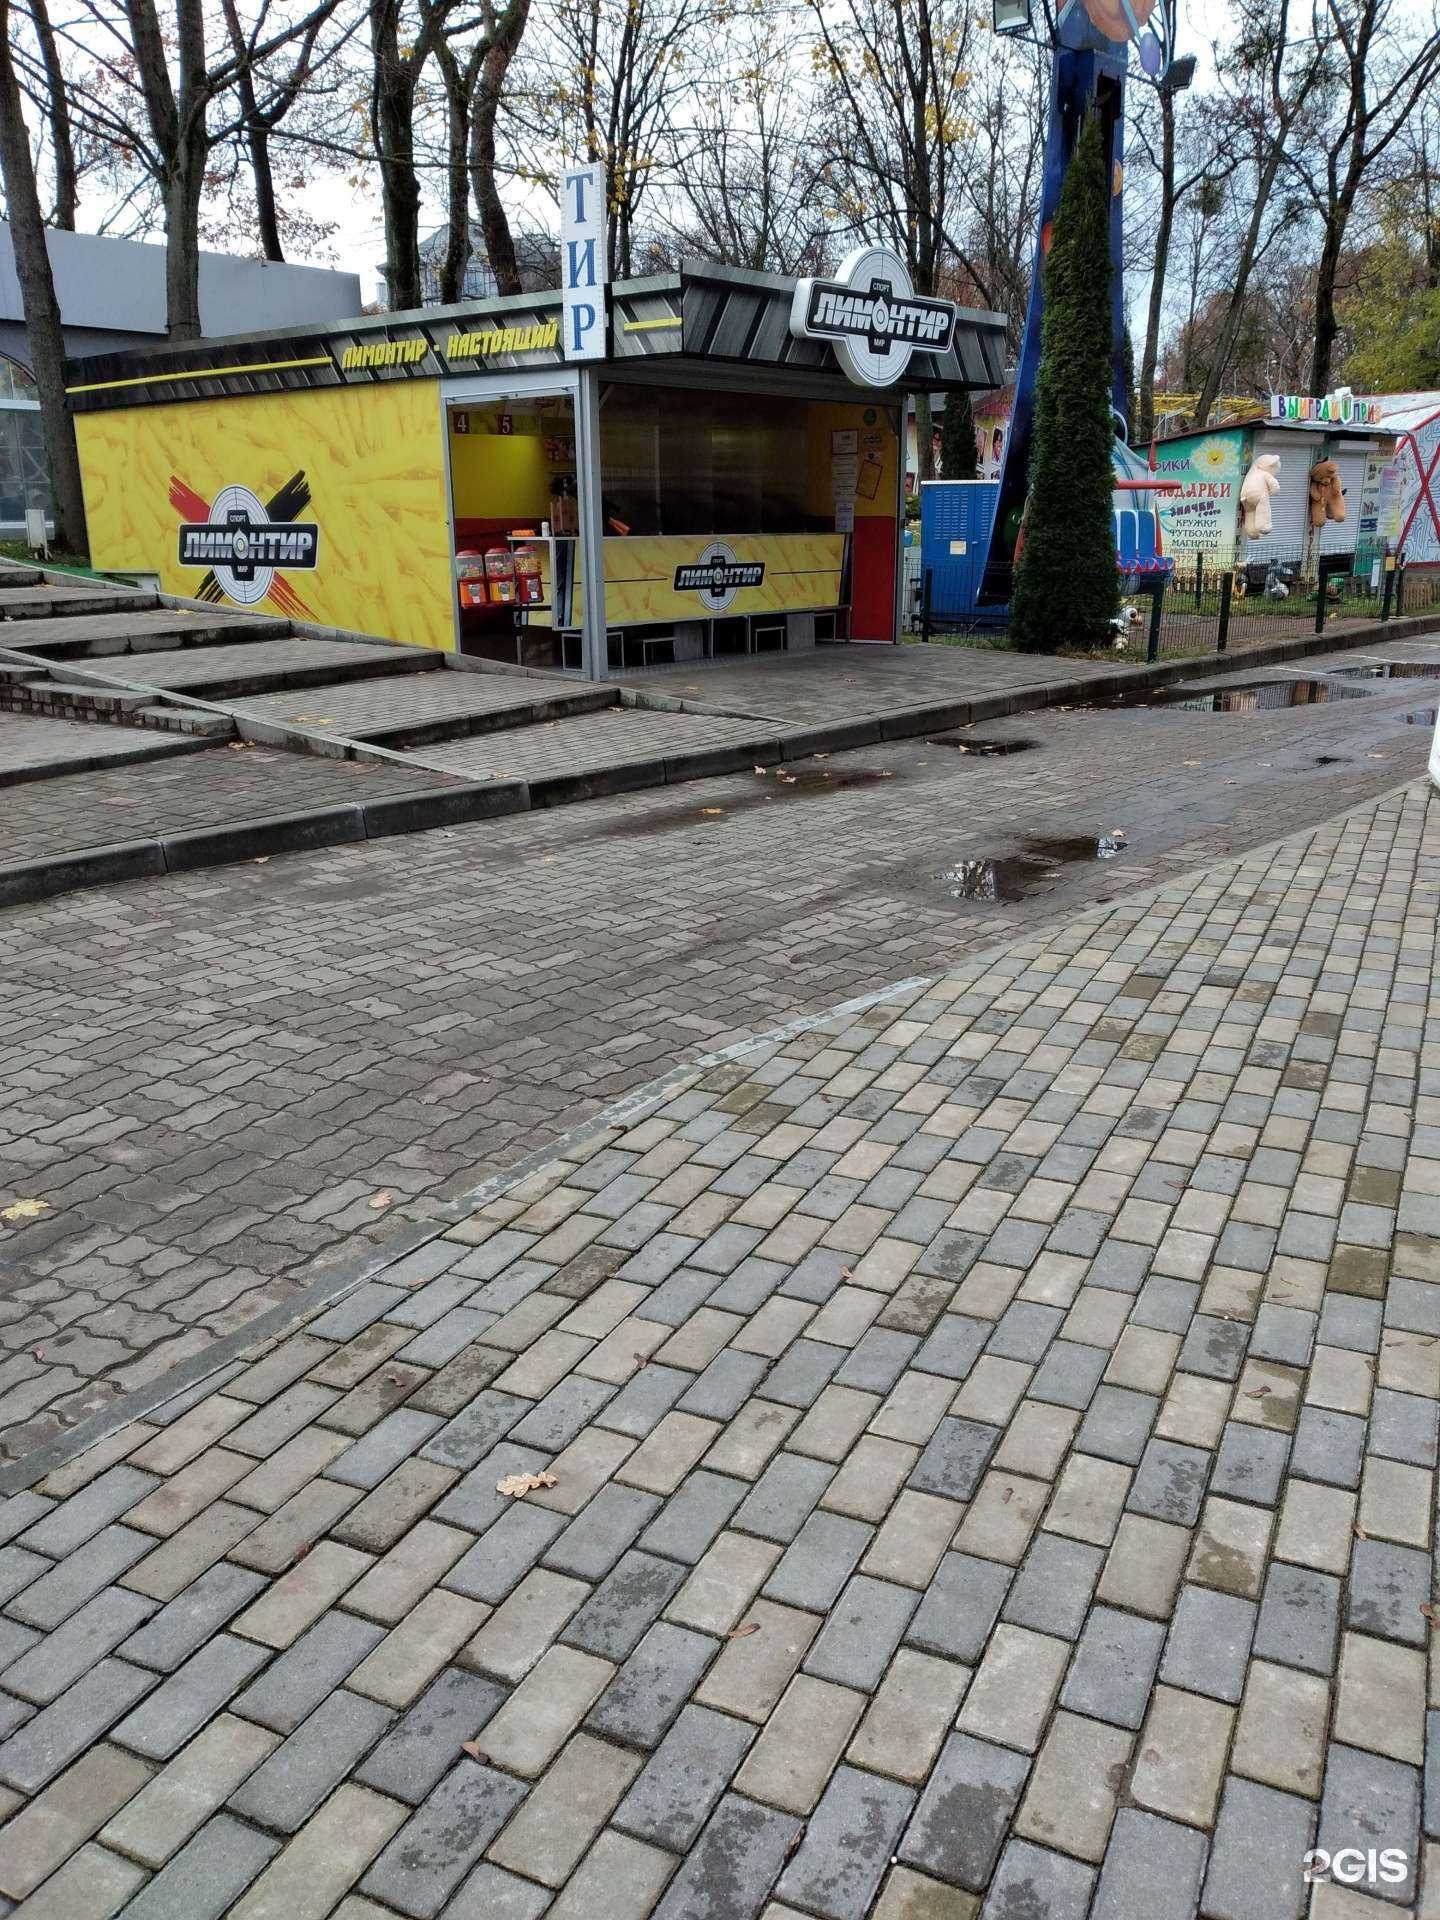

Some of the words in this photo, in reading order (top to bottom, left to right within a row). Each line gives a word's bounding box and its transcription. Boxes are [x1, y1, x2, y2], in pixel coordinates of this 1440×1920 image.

[566, 172, 597, 351] ТИР
[872, 282, 890, 292] СПОРТ
[813, 291, 949, 340] ЛИМОНТИР
[341, 339, 427, 369] ЛИМОНТИР
[446, 317, 558, 358] НАСТОЯЩИЙ
[873, 338, 886, 347] МИР
[457, 414, 467, 432] 4
[502, 416, 511, 434] 5
[229, 514, 246, 522] СПОРТ
[1176, 519, 1217, 527] КРУЖКИ
[1169, 529, 1222, 538] ФУТБОЛКИ
[184, 528, 313, 560] ЛИМОНТИР
[1171, 540, 1218, 548] МАГНИТЫ
[237, 565, 248, 573] МИР
[678, 566, 762, 586] ЛИМОНТИР
